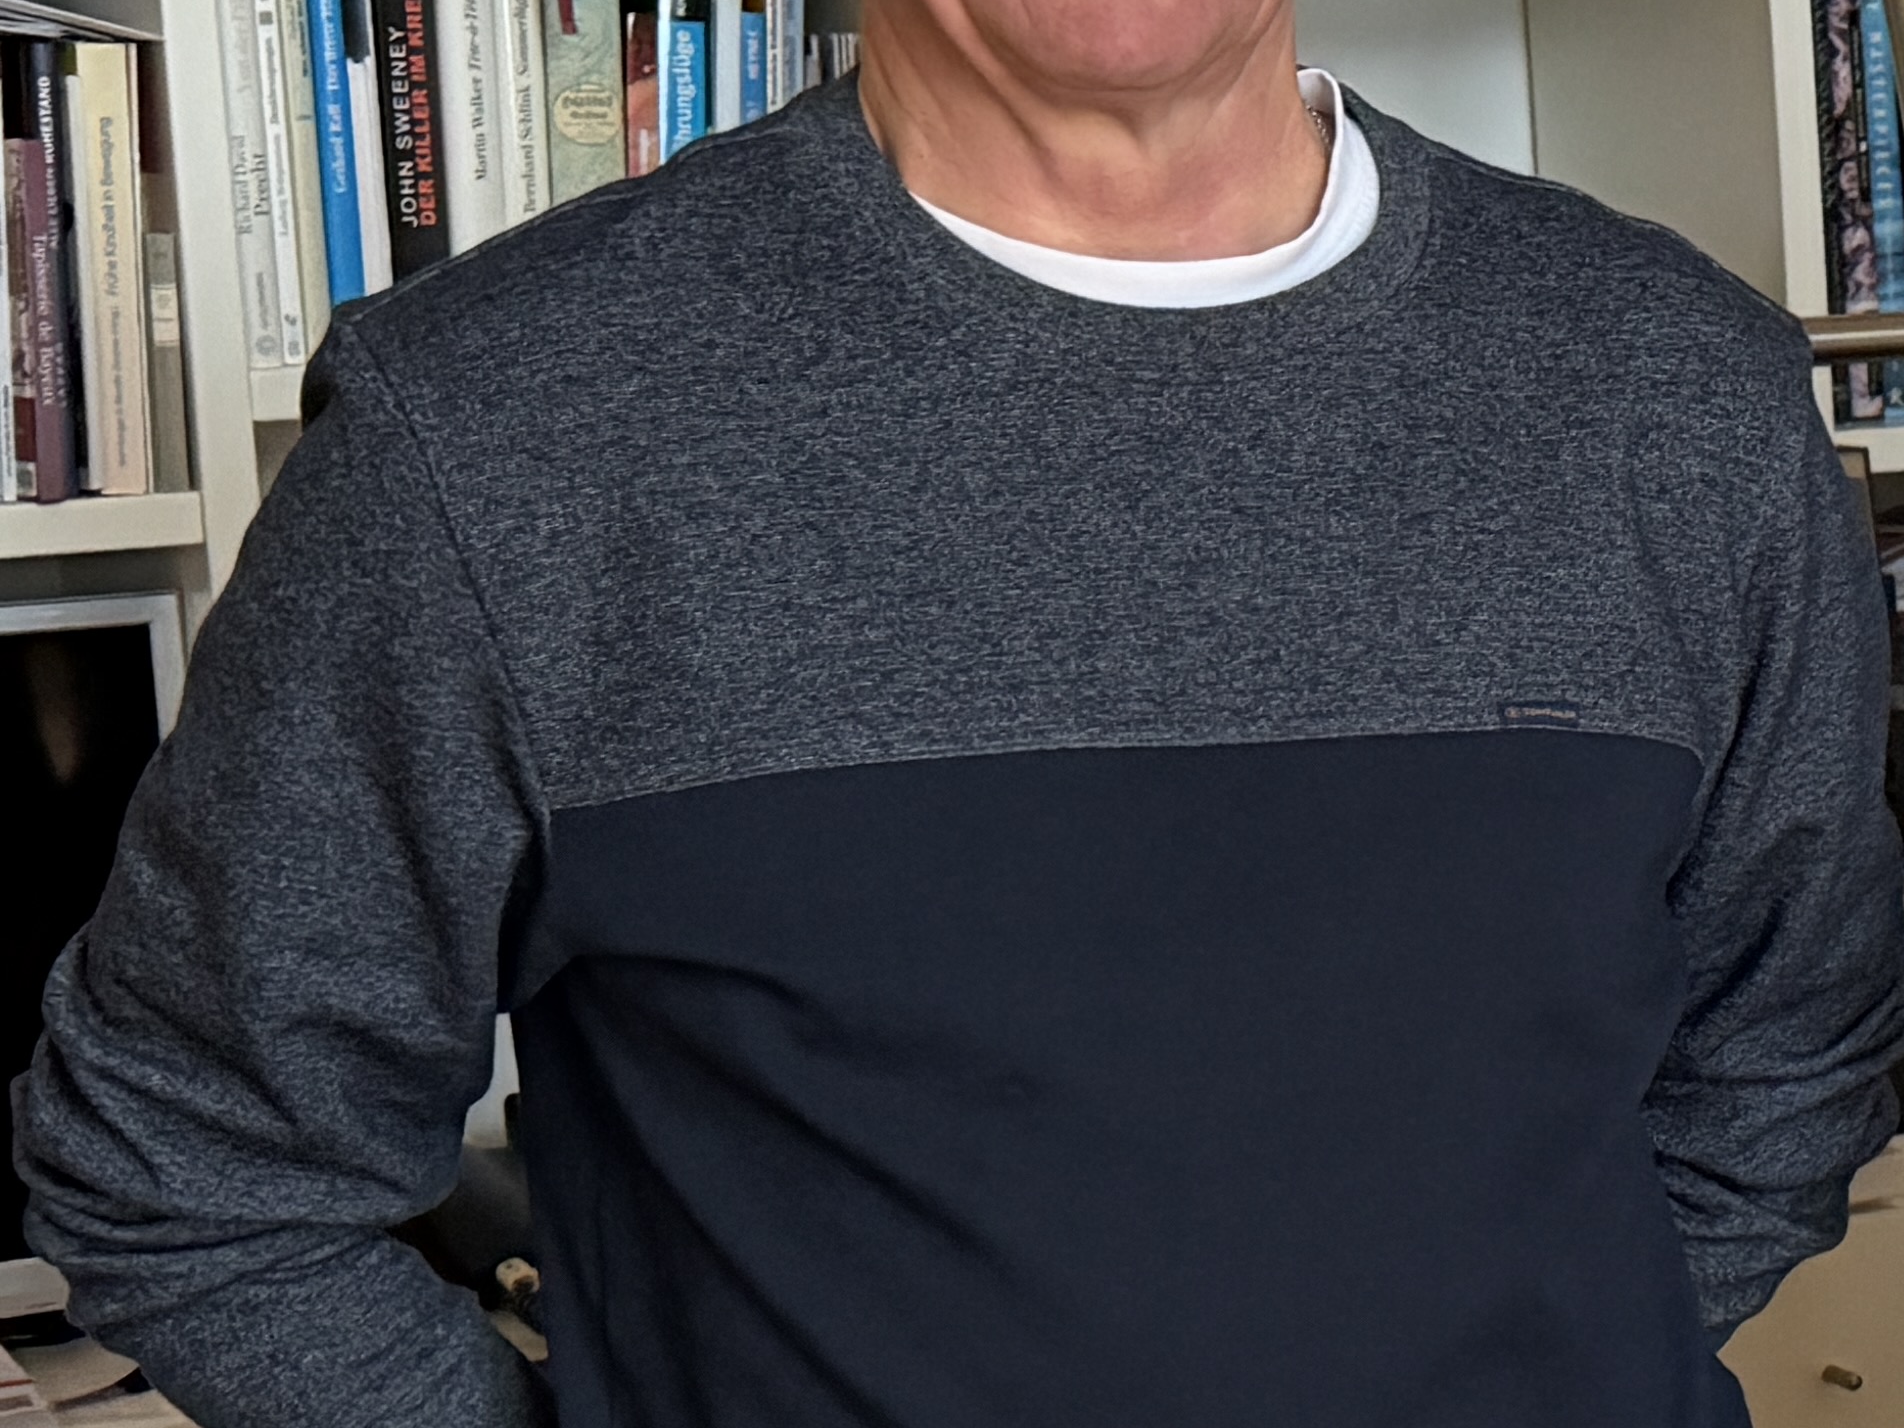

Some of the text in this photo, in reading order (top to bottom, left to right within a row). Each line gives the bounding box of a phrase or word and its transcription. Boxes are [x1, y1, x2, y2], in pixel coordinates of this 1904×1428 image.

[410, 54, 428, 82] IM
[387, 25, 419, 228] JOHN SWEENEY
[411, 88, 436, 173] KILLER
[468, 75, 485, 130] Walker
[516, 84, 535, 141] Schlink
[471, 132, 488, 181] Martin
[518, 143, 538, 213] Bernhard
[250, 153, 271, 218] Precht
[417, 179, 438, 226] DER
